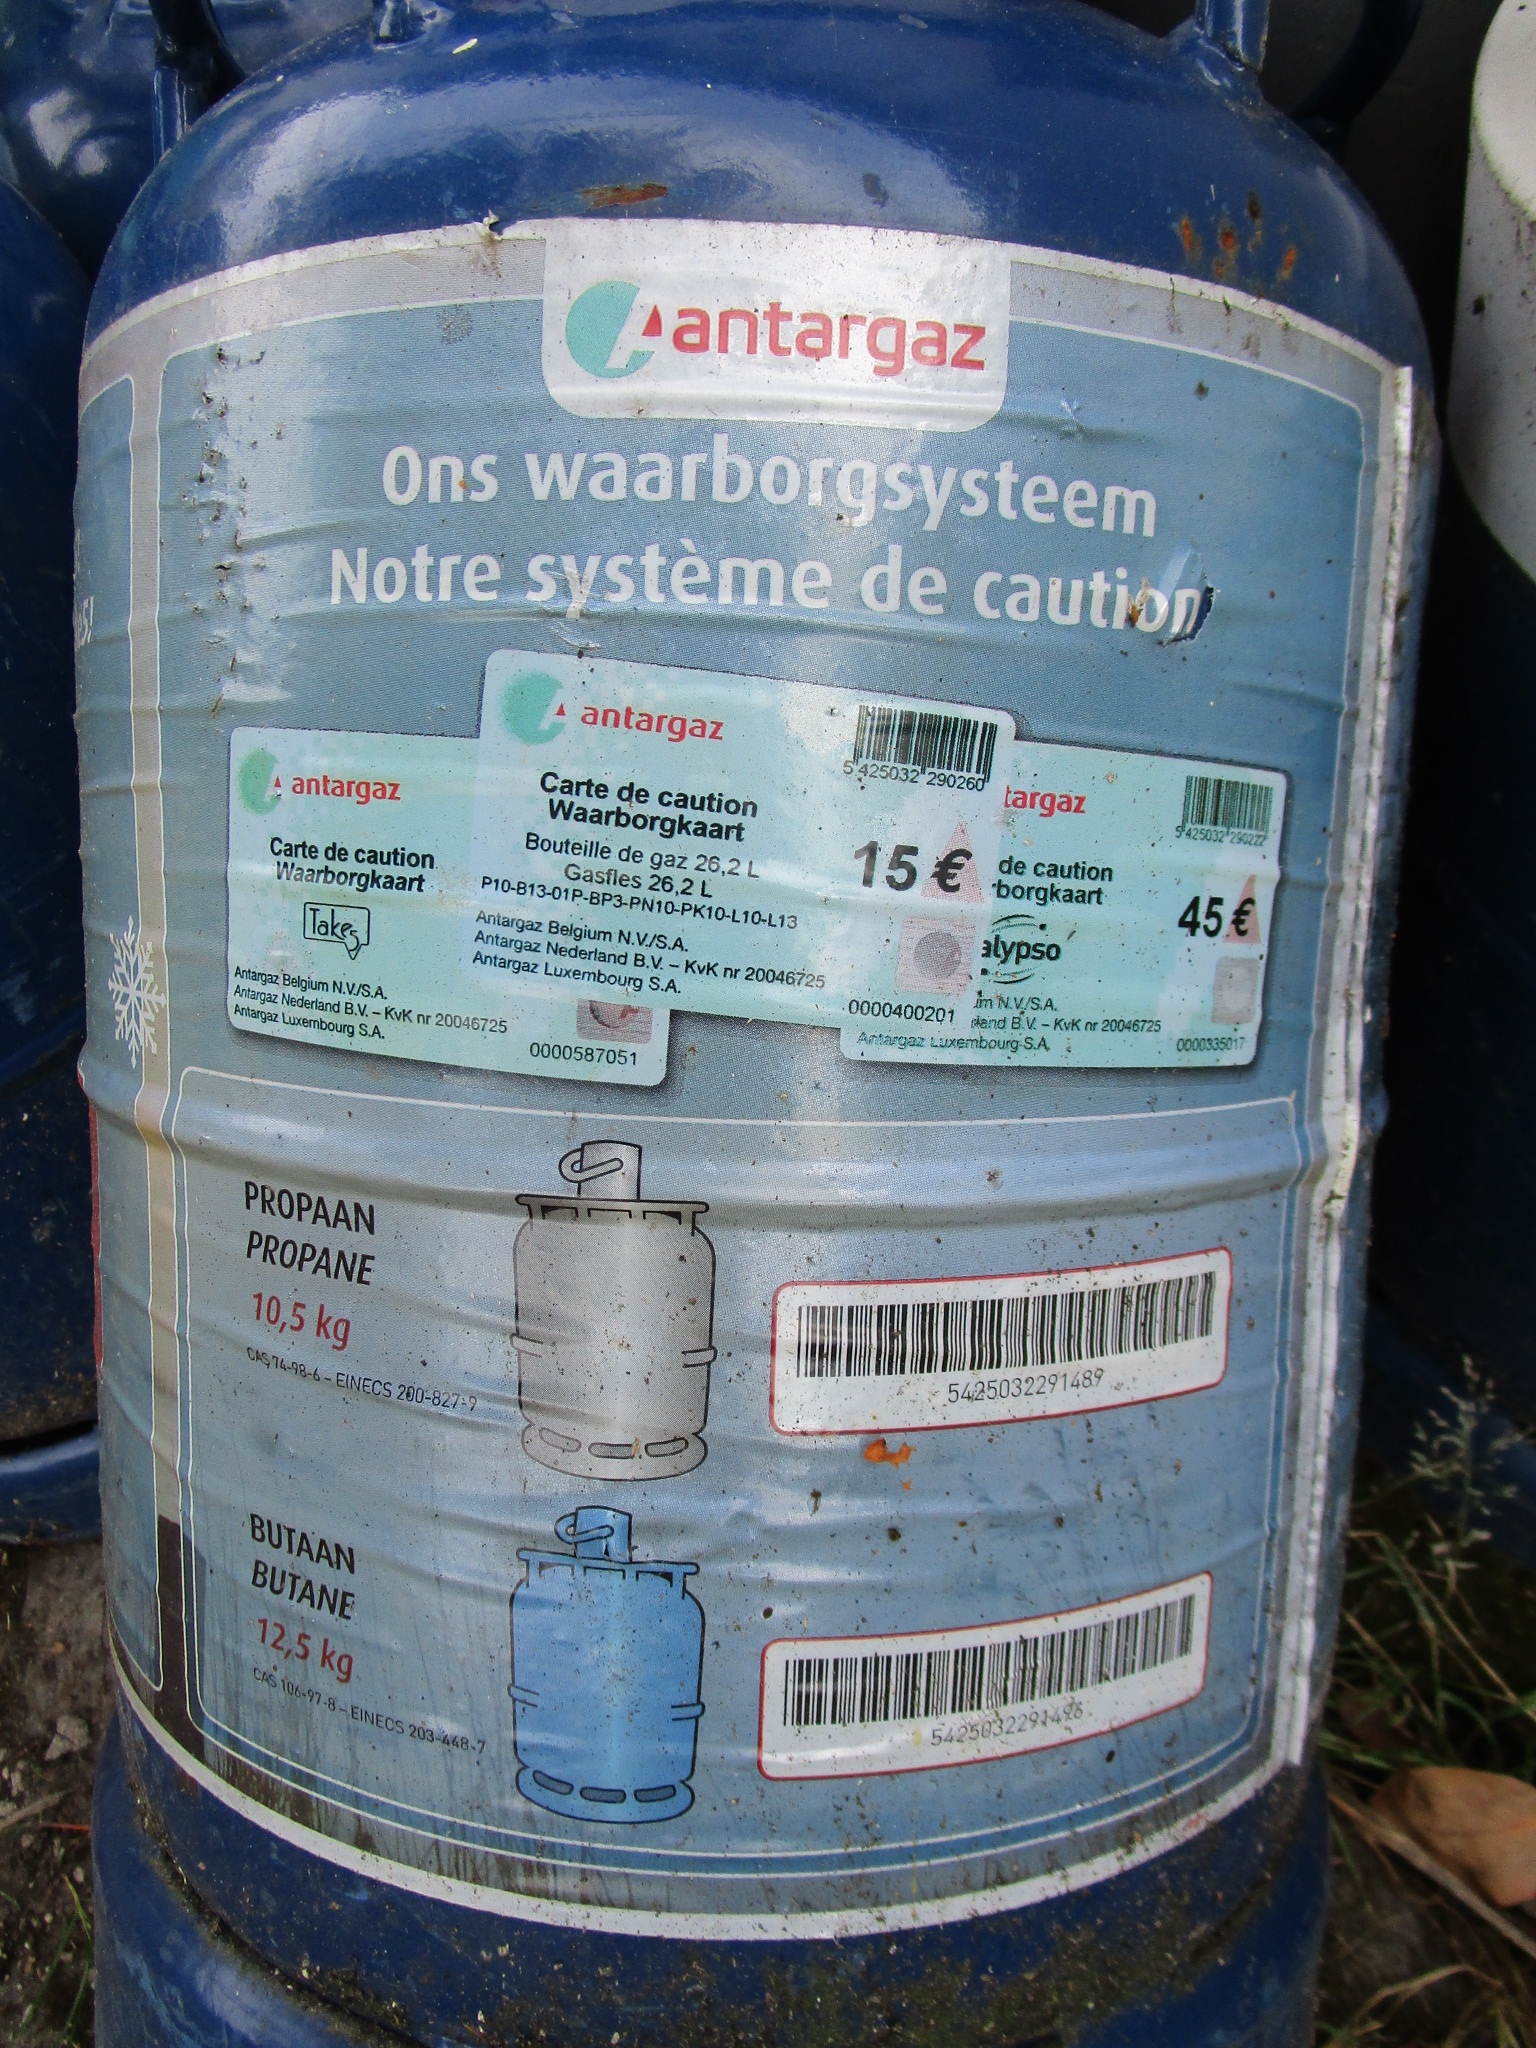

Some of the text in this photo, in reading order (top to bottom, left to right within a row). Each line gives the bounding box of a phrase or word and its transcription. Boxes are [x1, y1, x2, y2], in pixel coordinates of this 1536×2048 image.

[672, 301, 985, 375] antargaz
[382, 432, 1157, 537] Ons waarborgsysteem
[331, 538, 1199, 641] Notre système de caution
[581, 704, 724, 742] antargaz
[292, 775, 401, 805] antargaz
[540, 771, 758, 818] Carte de caution
[858, 763, 919, 783] 425032
[926, 772, 986, 791] 290260
[548, 798, 745, 843] Waarborgkaart
[270, 837, 435, 869] Carte de caution
[525, 832, 759, 879] Bouteille de gaz 26,2 L
[854, 841, 973, 893] 15 €
[999, 855, 1113, 881] de caution
[276, 861, 425, 892] Waarborgkaart
[564, 863, 713, 898] Gasfles 26,2 L
[992, 879, 1104, 906] borgkaart
[481, 877, 798, 929] P10-B13-01P-BP3-PN10-PK10-L10-L13
[1178, 896, 1255, 938] 45 €
[477, 911, 688, 952] Antargaz Belgium N.V./S.A.
[473, 952, 681, 994] Antargaz Luxembourg S.A.
[474, 931, 541, 954] Antargaz
[546, 939, 628, 967] Nederland
[634, 951, 664, 970] B.V.
[684, 958, 719, 977] KvK
[723, 965, 740, 980] nr
[744, 964, 826, 989] 20046725
[235, 966, 387, 1000] Antargaz Belgium N.V./S.A.
[234, 985, 278, 1005] Antargaz
[281, 991, 340, 1013] Nederland
[344, 1001, 368, 1016] B.V.
[385, 1006, 412, 1023] KvK
[417, 1015, 431, 1026] nr
[435, 1012, 508, 1034] 20046725
[234, 1004, 385, 1039] Antargaz Luxembourg S.A.
[848, 999, 955, 1023] 0000400201
[1011, 1017, 1036, 1030] B.V.
[1053, 1018, 1082, 1031] KvK
[1085, 1021, 1098, 1031] nr
[1101, 1019, 1161, 1032] 20046725
[529, 1042, 638, 1066] 0000587051
[857, 1031, 925, 1049] Antargaz
[930, 1034, 1019, 1053] Luxembourg
[244, 1180, 375, 1235] PROPAAN
[246, 1231, 375, 1285] PROPANE
[252, 1293, 350, 1351] 10,5 kg
[247, 1347, 270, 1365] CAS
[272, 1356, 320, 1381] 74-98-6
[336, 1372, 392, 1397] EINECS
[397, 1384, 477, 1412] 200-827-9
[946, 1368, 1104, 1404] 5425032291489
[250, 1513, 355, 1575] BUTAAN
[251, 1560, 355, 1621] BUTANE
[258, 1618, 354, 1683] 12,5 kg
[253, 1667, 277, 1688] CAS
[281, 1678, 336, 1712] 106-97-8
[350, 1706, 405, 1734] EINECS
